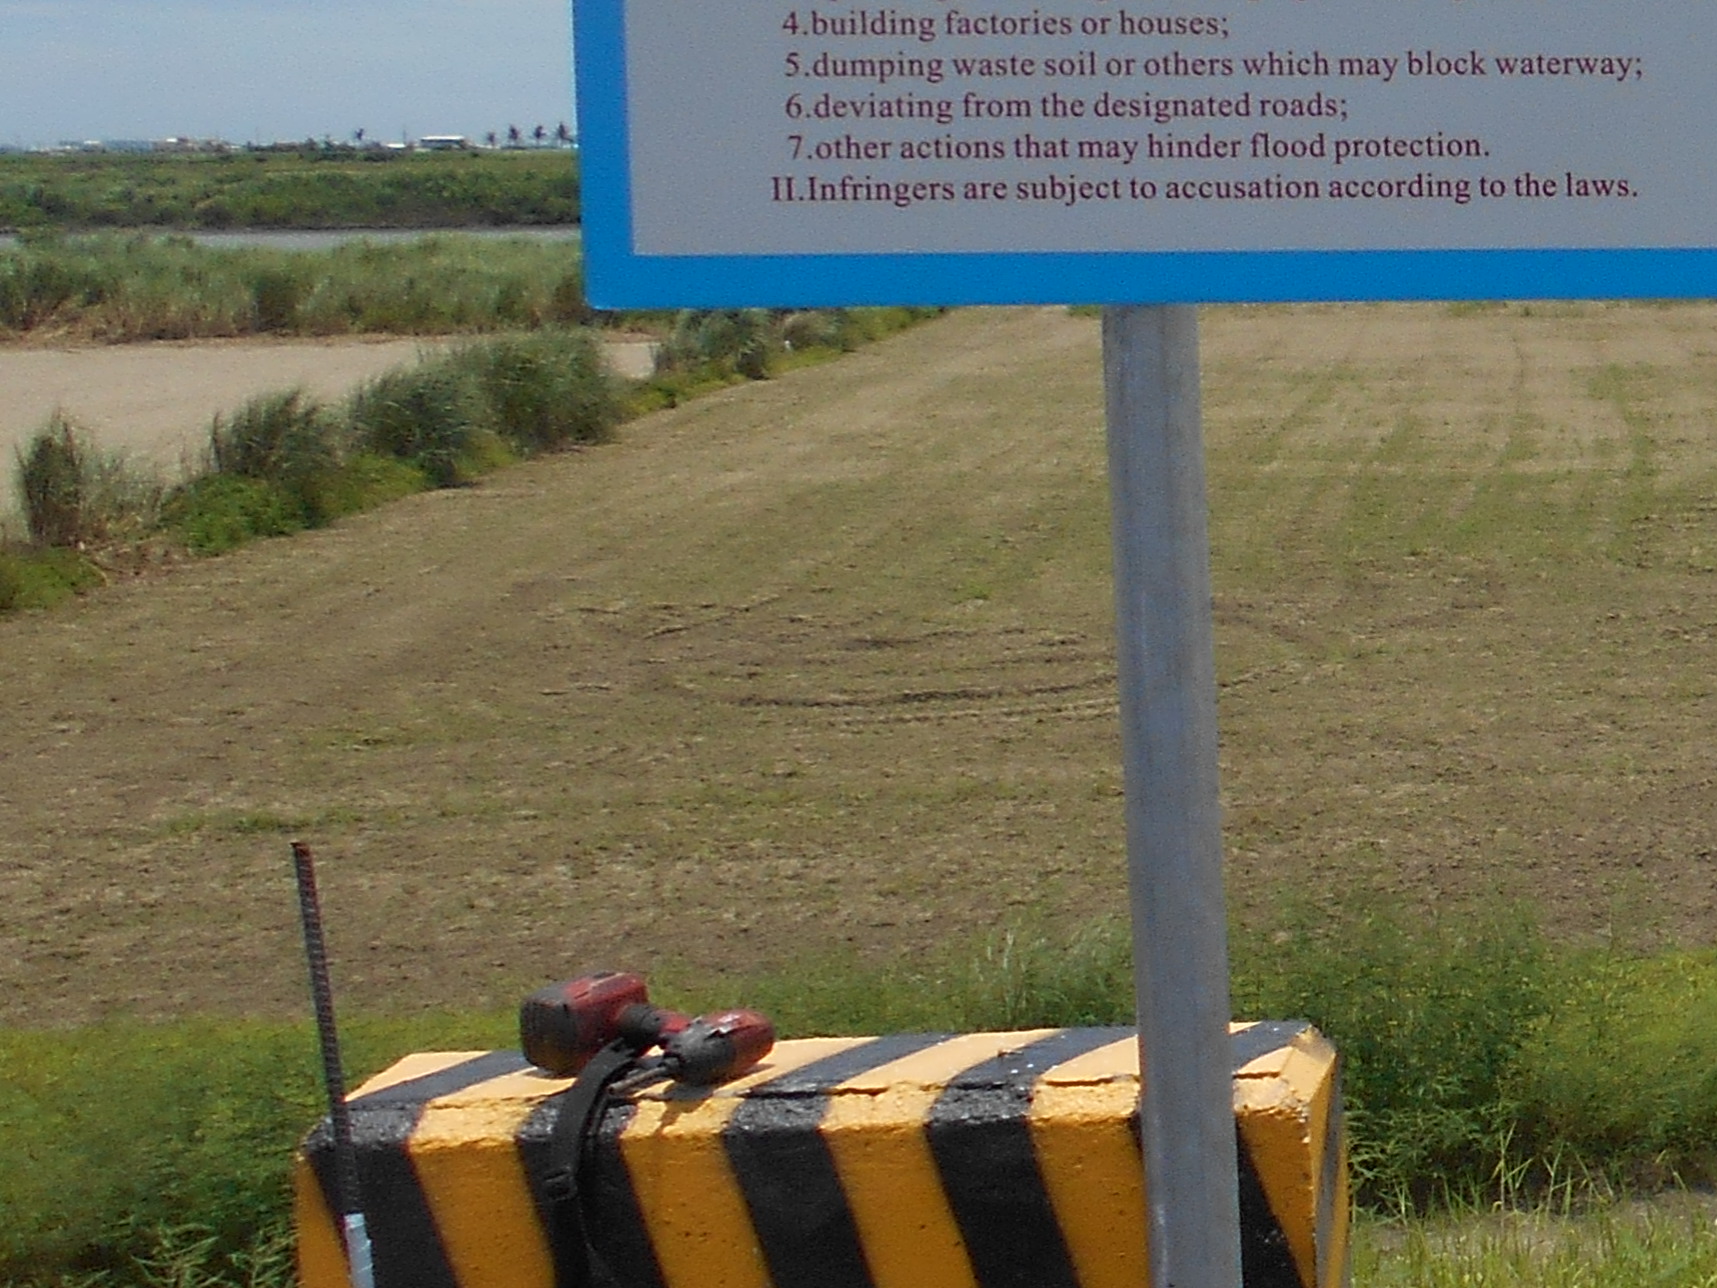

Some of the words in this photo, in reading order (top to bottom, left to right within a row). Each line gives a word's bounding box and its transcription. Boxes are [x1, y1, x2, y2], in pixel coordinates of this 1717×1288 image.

[781, 9, 937, 43] 4.building
[944, 9, 1073, 36] factories
[1080, 16, 1113, 36] or
[1118, 9, 1229, 40] houses;
[784, 50, 945, 84] 5.dumping
[951, 54, 1036, 77] waste
[1043, 50, 1097, 77] soil
[1105, 57, 1137, 77] or
[1142, 50, 1234, 77] others
[1241, 49, 1330, 77] which
[1338, 57, 1399, 83] may
[1405, 49, 1488, 77] block
[1494, 53, 1643, 83] waterway;
[784, 91, 954, 126] 6.deviating
[962, 91, 1032, 119] from
[1040, 91, 1086, 119] the
[1093, 91, 1251, 125] designated
[1258, 91, 1348, 123] roads;
[786, 133, 893, 161] 7.other
[899, 132, 1006, 160] actions
[1013, 132, 1070, 159] that
[1076, 140, 1139, 166] may
[1146, 132, 1242, 159] hinder
[1249, 132, 1327, 159] flood
[1333, 132, 1490, 165] protection.
[770, 174, 956, 206] II.Infringers
[963, 181, 1008, 201] are
[1015, 173, 1122, 206] subject
[1129, 176, 1157, 200] to
[1165, 172, 1321, 200] accusation
[1328, 171, 1472, 206] according
[1478, 175, 1507, 198] to
[1513, 171, 1558, 198] the
[1564, 171, 1638, 198] laws.
